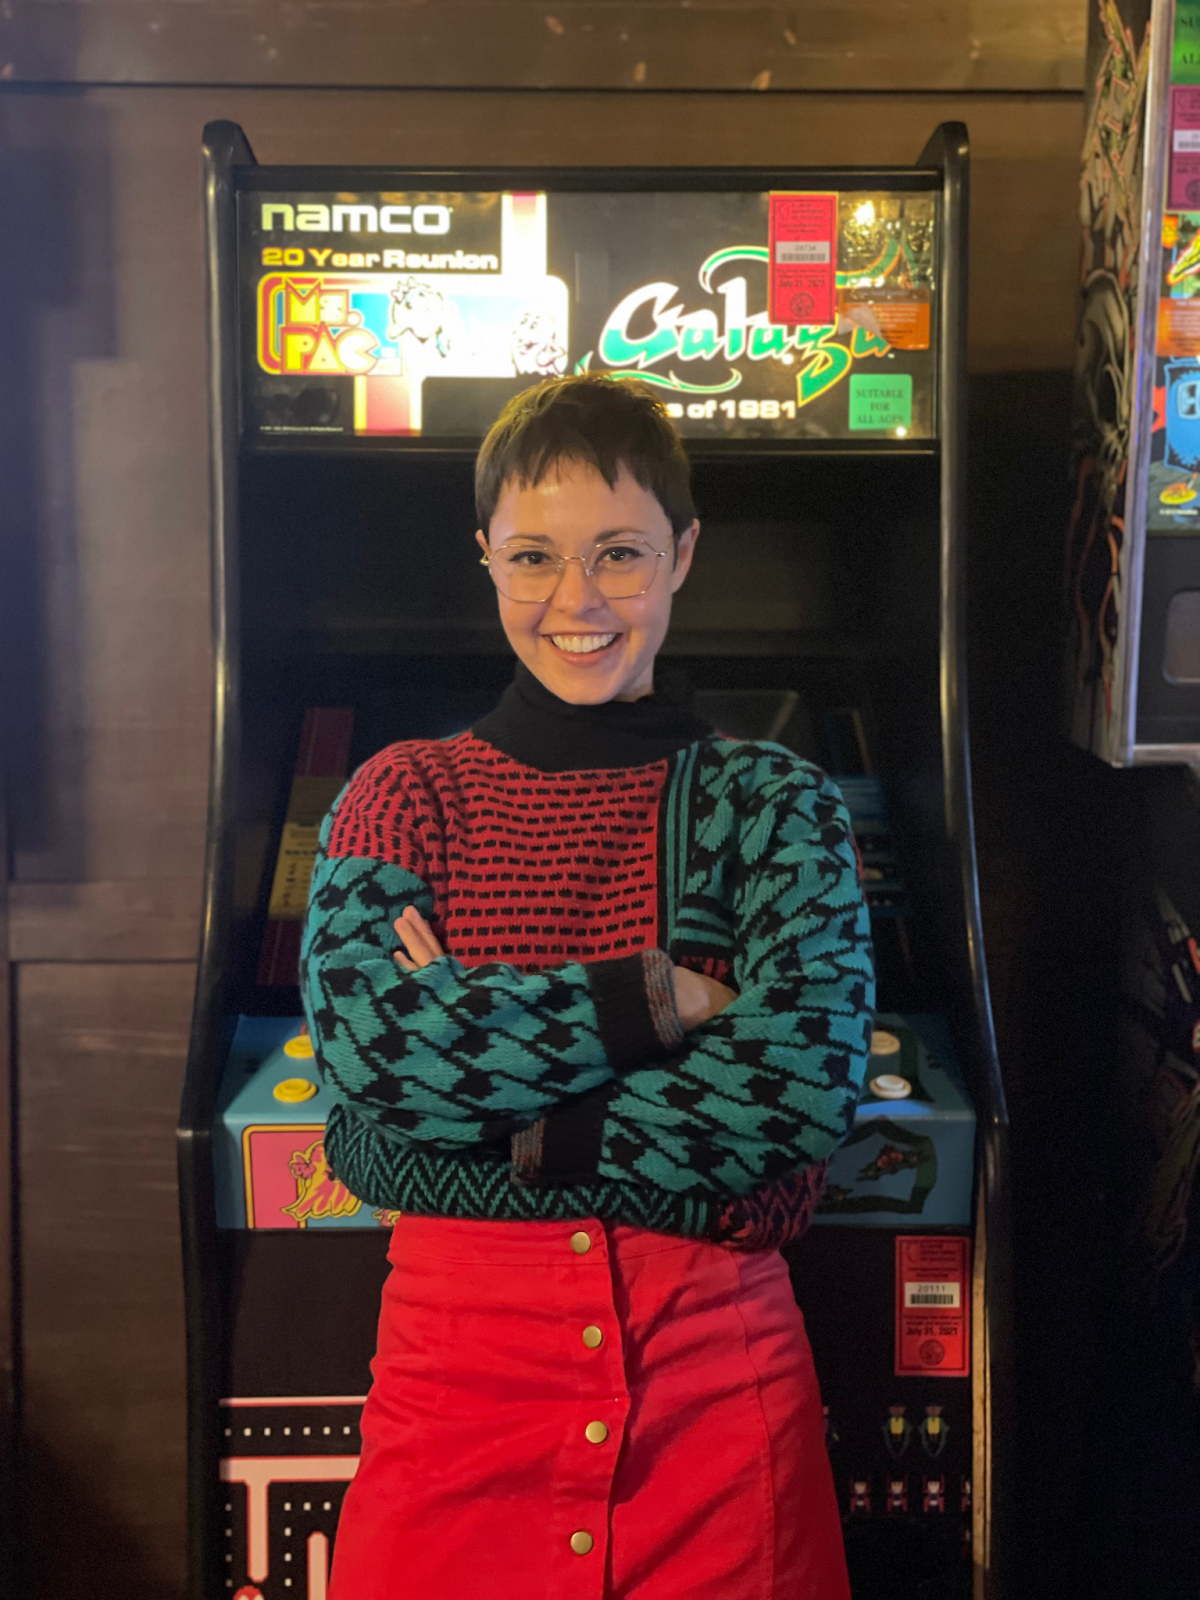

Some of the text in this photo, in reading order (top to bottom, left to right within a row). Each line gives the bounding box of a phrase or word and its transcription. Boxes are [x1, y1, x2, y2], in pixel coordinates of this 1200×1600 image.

[261, 203, 451, 235] namco
[261, 247, 499, 270] 20 Year Reunion
[855, 388, 904, 399] SUITABLE
[686, 399, 717, 419] of
[719, 399, 797, 419] 1981
[870, 402, 890, 411] FOR
[856, 414, 874, 424] ALL
[917, 1284, 945, 1293] 20111
[906, 1326, 922, 1336] July
